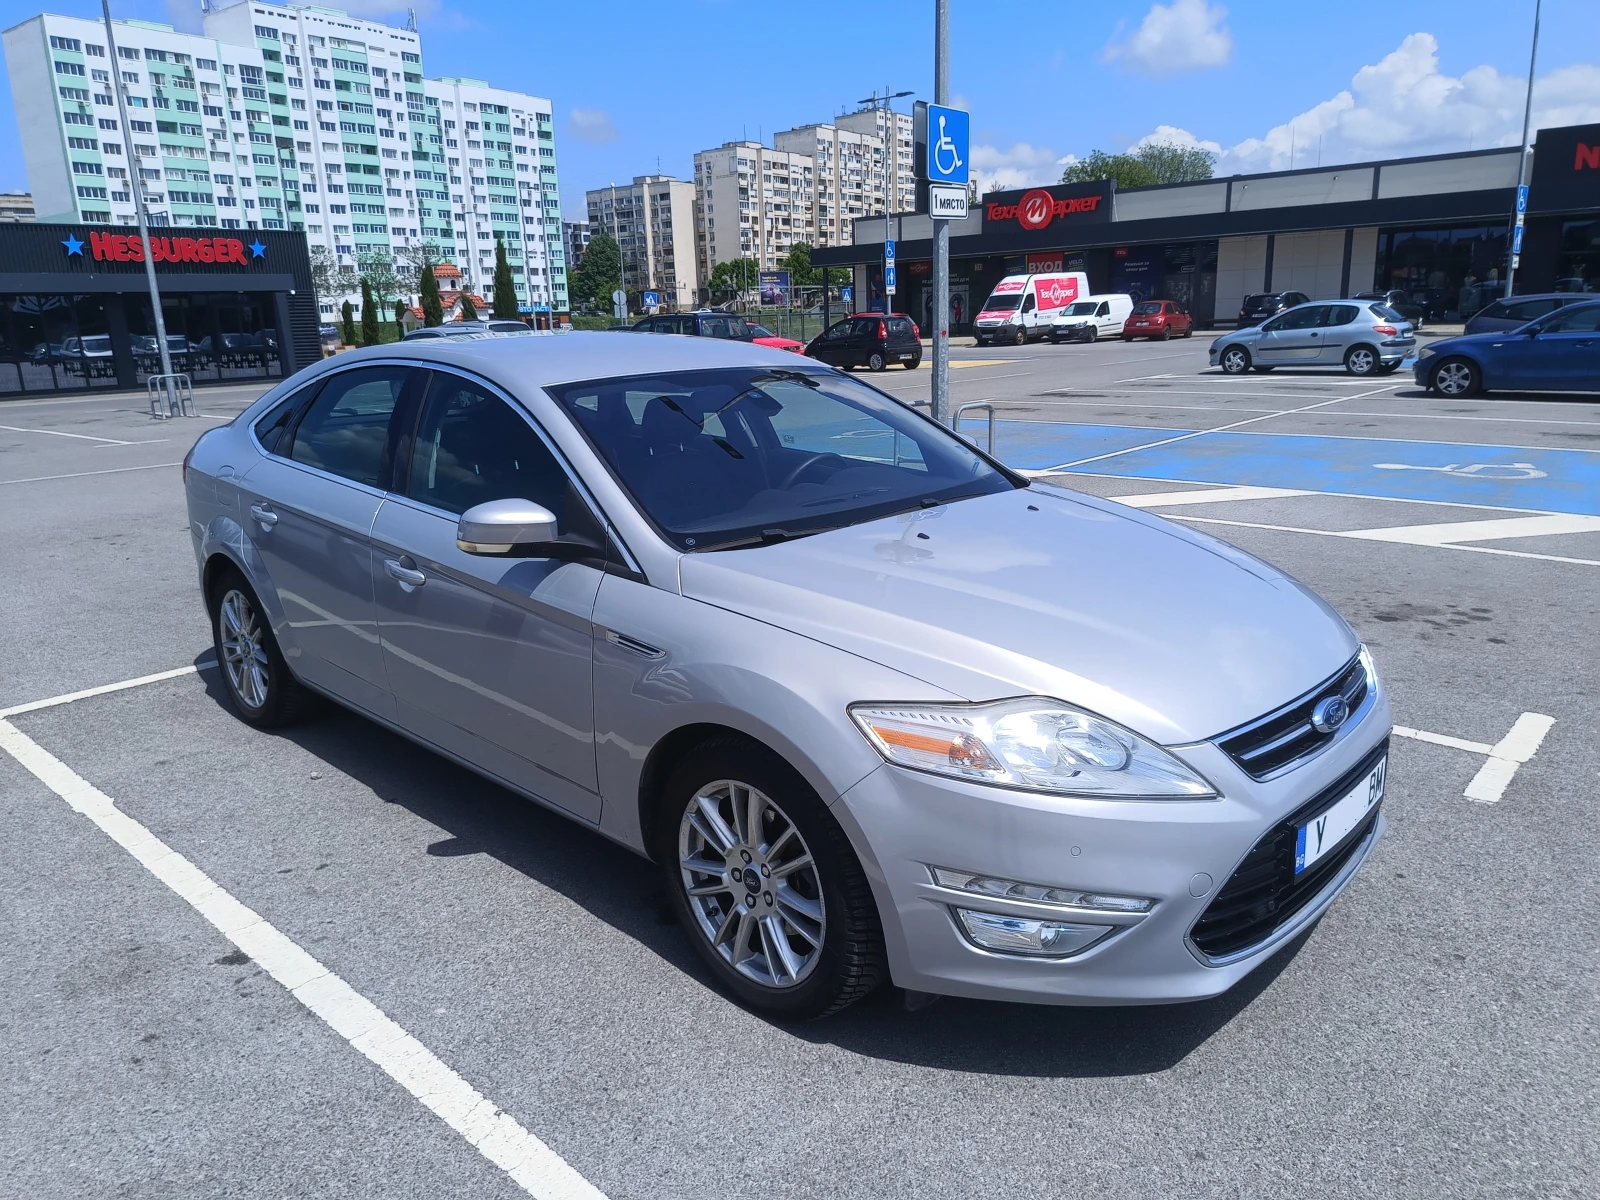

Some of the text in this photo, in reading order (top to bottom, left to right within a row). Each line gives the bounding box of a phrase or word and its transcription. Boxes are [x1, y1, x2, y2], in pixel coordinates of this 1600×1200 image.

[934, 194, 965, 210] 1 МЯСТО
[90, 231, 248, 266] HESBURGER
[1028, 260, 1063, 273] ВХОД
[1068, 258, 1083, 266] VELO
[1295, 853, 1305, 867] BG
